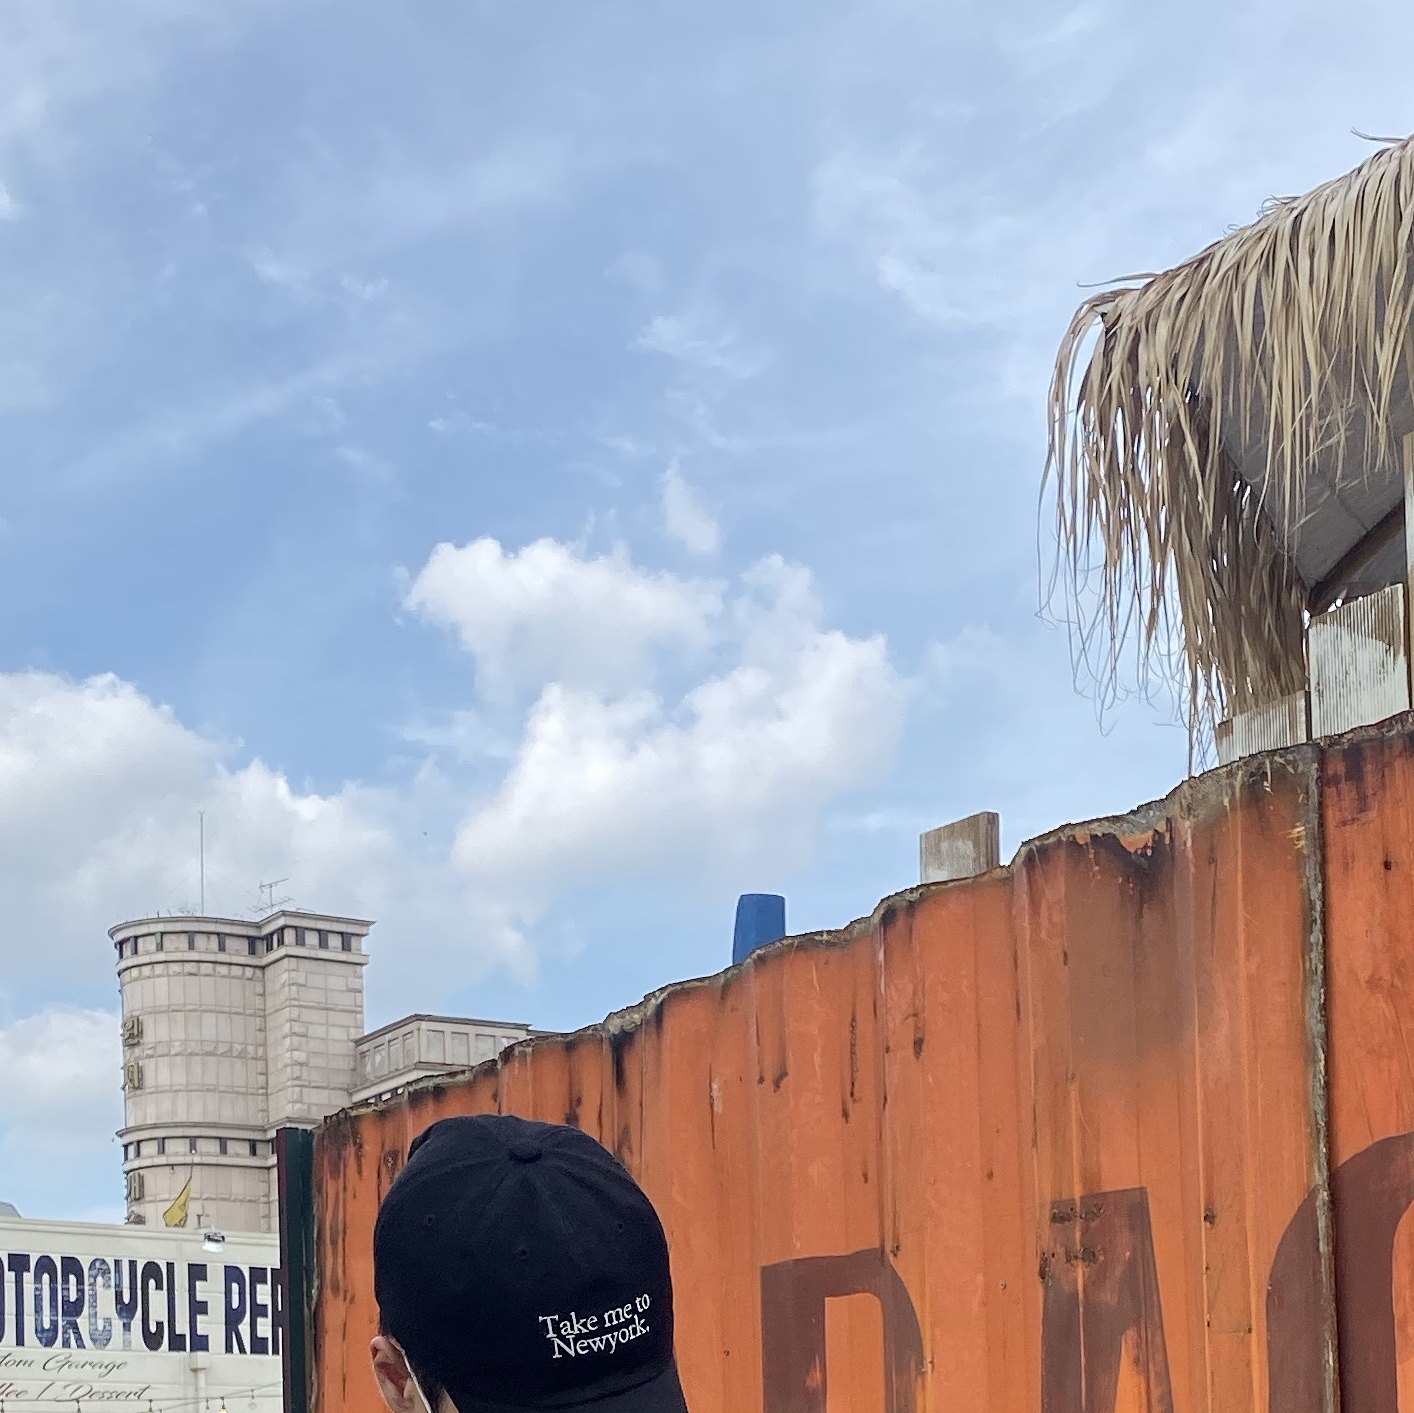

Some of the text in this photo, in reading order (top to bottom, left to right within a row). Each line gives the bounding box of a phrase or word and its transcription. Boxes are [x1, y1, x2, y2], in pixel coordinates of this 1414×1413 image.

[539, 1294, 650, 1338] Take me to
[550, 1314, 650, 1358] Newyork.
[42, 1352, 128, 1379] Garage
[54, 1382, 151, 1402] Dessert
